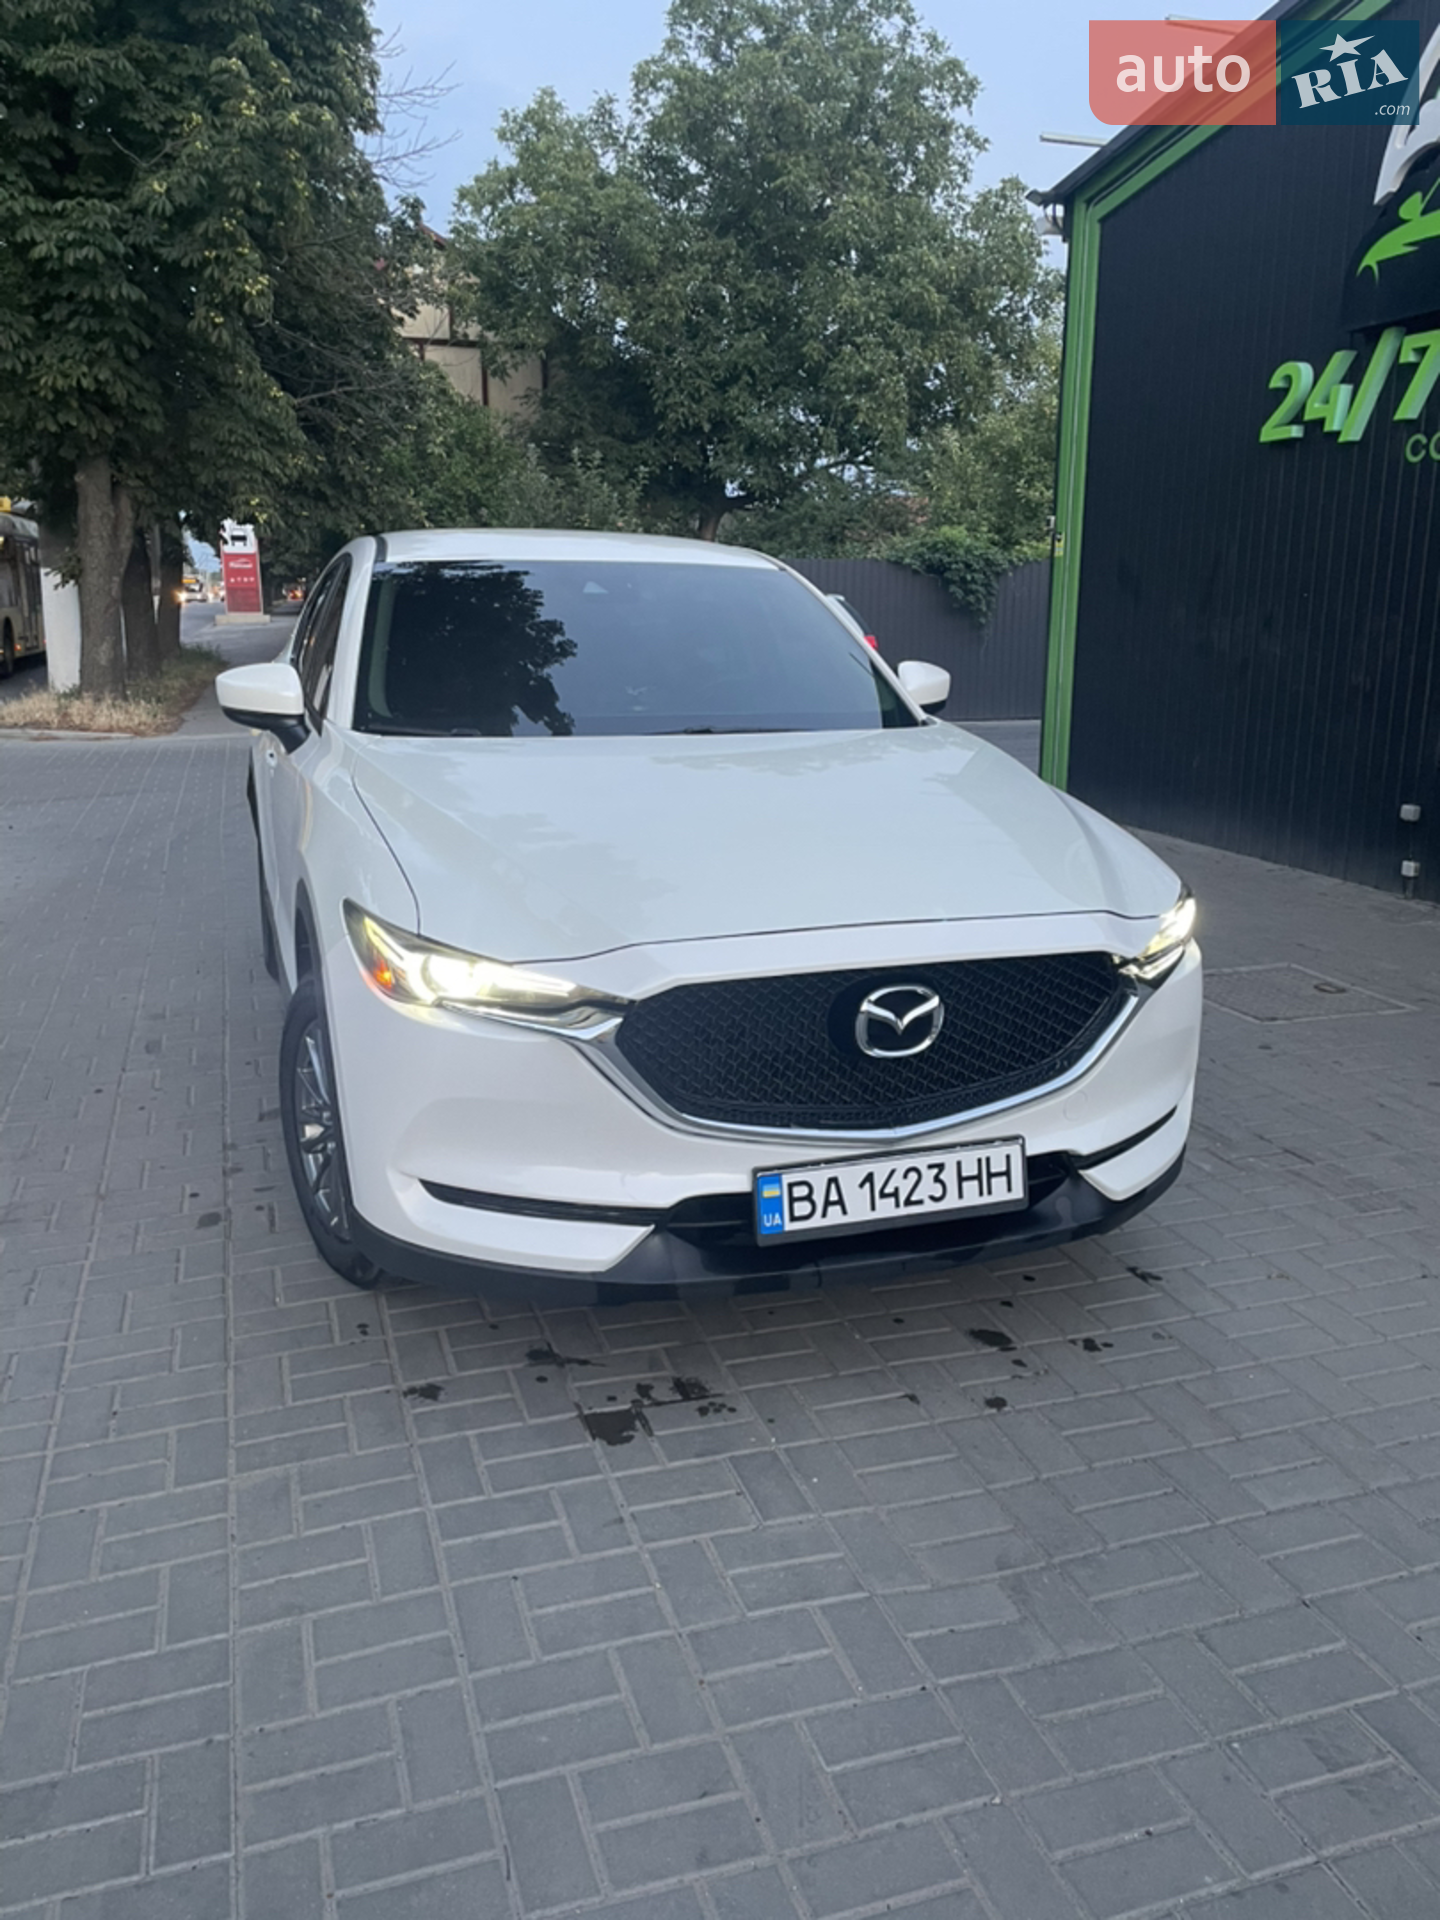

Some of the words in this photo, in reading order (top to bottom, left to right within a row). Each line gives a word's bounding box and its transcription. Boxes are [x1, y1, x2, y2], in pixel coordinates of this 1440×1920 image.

[1258, 326, 1440, 443] 24/7
[763, 1212, 783, 1228] UA
[787, 1176, 849, 1223] BA
[858, 1162, 947, 1212] 1423
[956, 1153, 1013, 1200] HH
